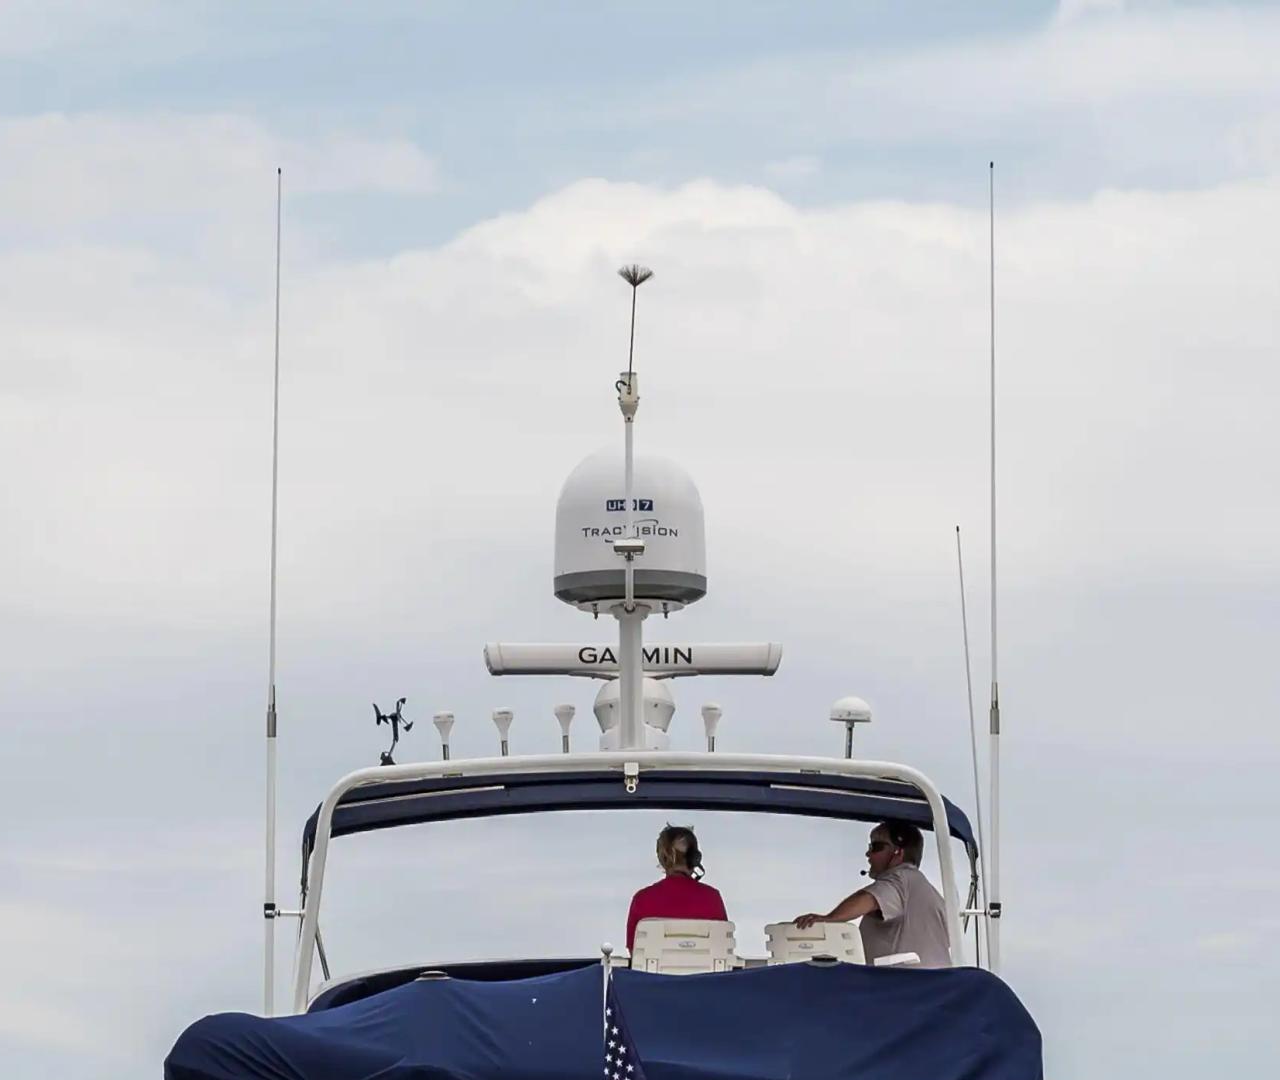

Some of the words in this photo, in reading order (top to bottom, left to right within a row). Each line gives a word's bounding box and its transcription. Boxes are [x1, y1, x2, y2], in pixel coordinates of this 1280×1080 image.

[607, 501, 636, 510] UH
[582, 524, 678, 538] TRACISION
[578, 646, 693, 665] GAMIN
